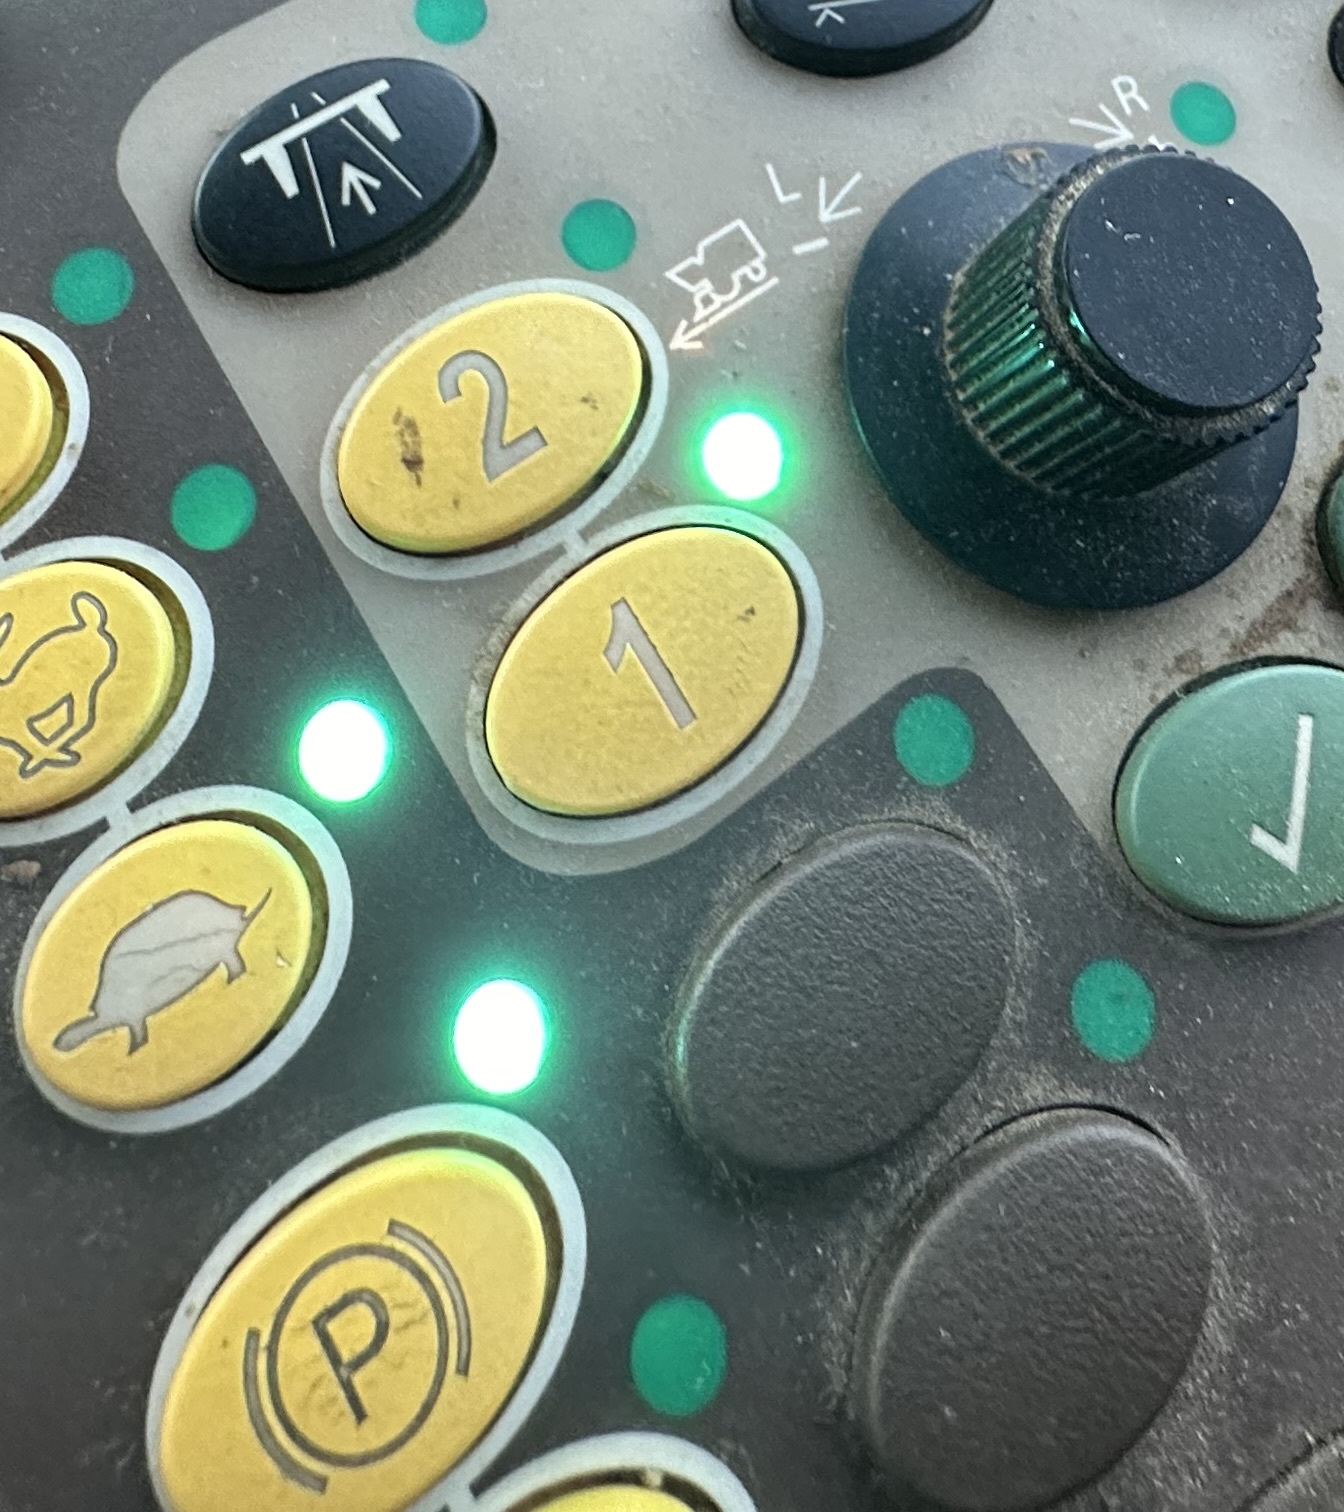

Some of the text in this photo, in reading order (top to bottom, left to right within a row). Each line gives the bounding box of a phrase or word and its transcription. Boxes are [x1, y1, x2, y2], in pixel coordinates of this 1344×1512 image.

[1111, 74, 1154, 117] R
[765, 162, 803, 205] L
[437, 349, 549, 483] 2
[602, 596, 698, 730] 1
[311, 1287, 391, 1426] P
